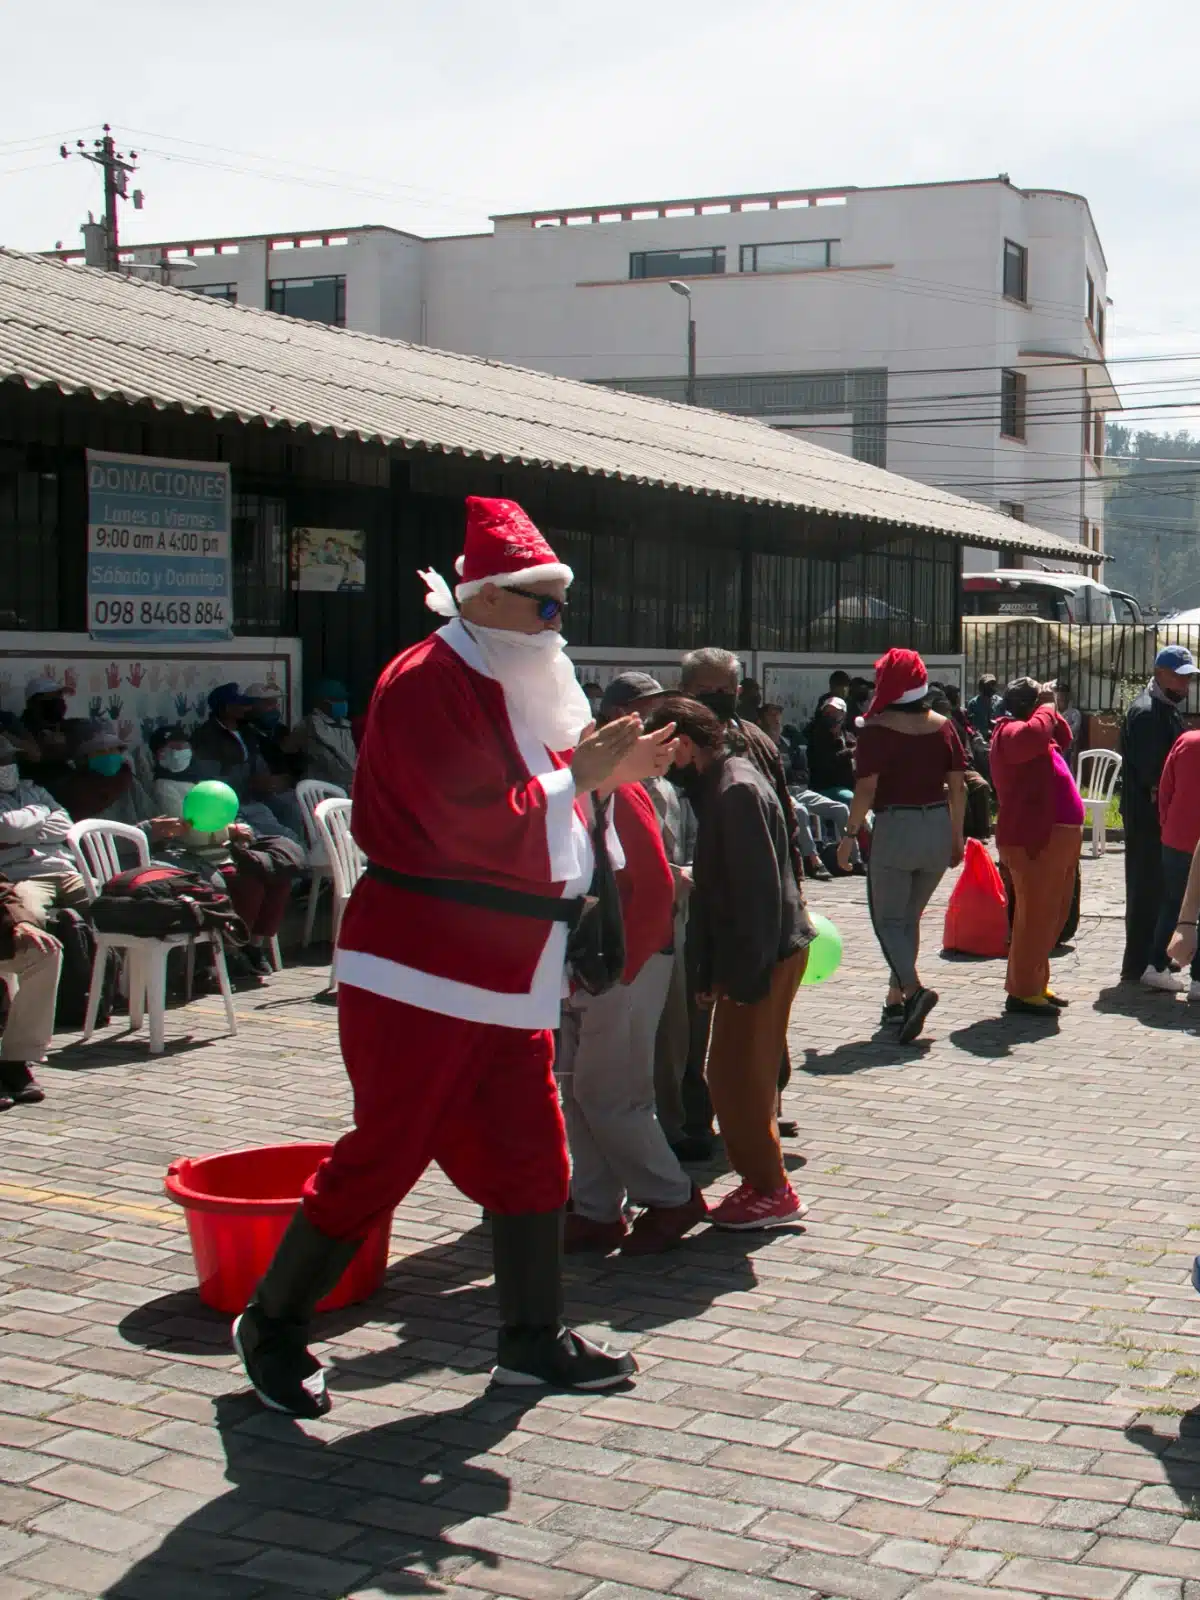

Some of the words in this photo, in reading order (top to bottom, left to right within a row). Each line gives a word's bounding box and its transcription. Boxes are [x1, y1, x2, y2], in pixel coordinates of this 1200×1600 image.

[90, 465, 225, 498] DONACIONES
[104, 504, 148, 524] Lunes
[151, 511, 160, 525] a
[164, 508, 216, 529] Viernes
[96, 528, 130, 548] 9:00
[133, 533, 153, 548] am
[156, 533, 166, 550] A
[169, 533, 198, 551] 4:00
[151, 571, 162, 590] y
[167, 568, 224, 591] Domingo
[95, 600, 134, 624] 098
[140, 601, 191, 624] 8468
[194, 602, 224, 624] 884
